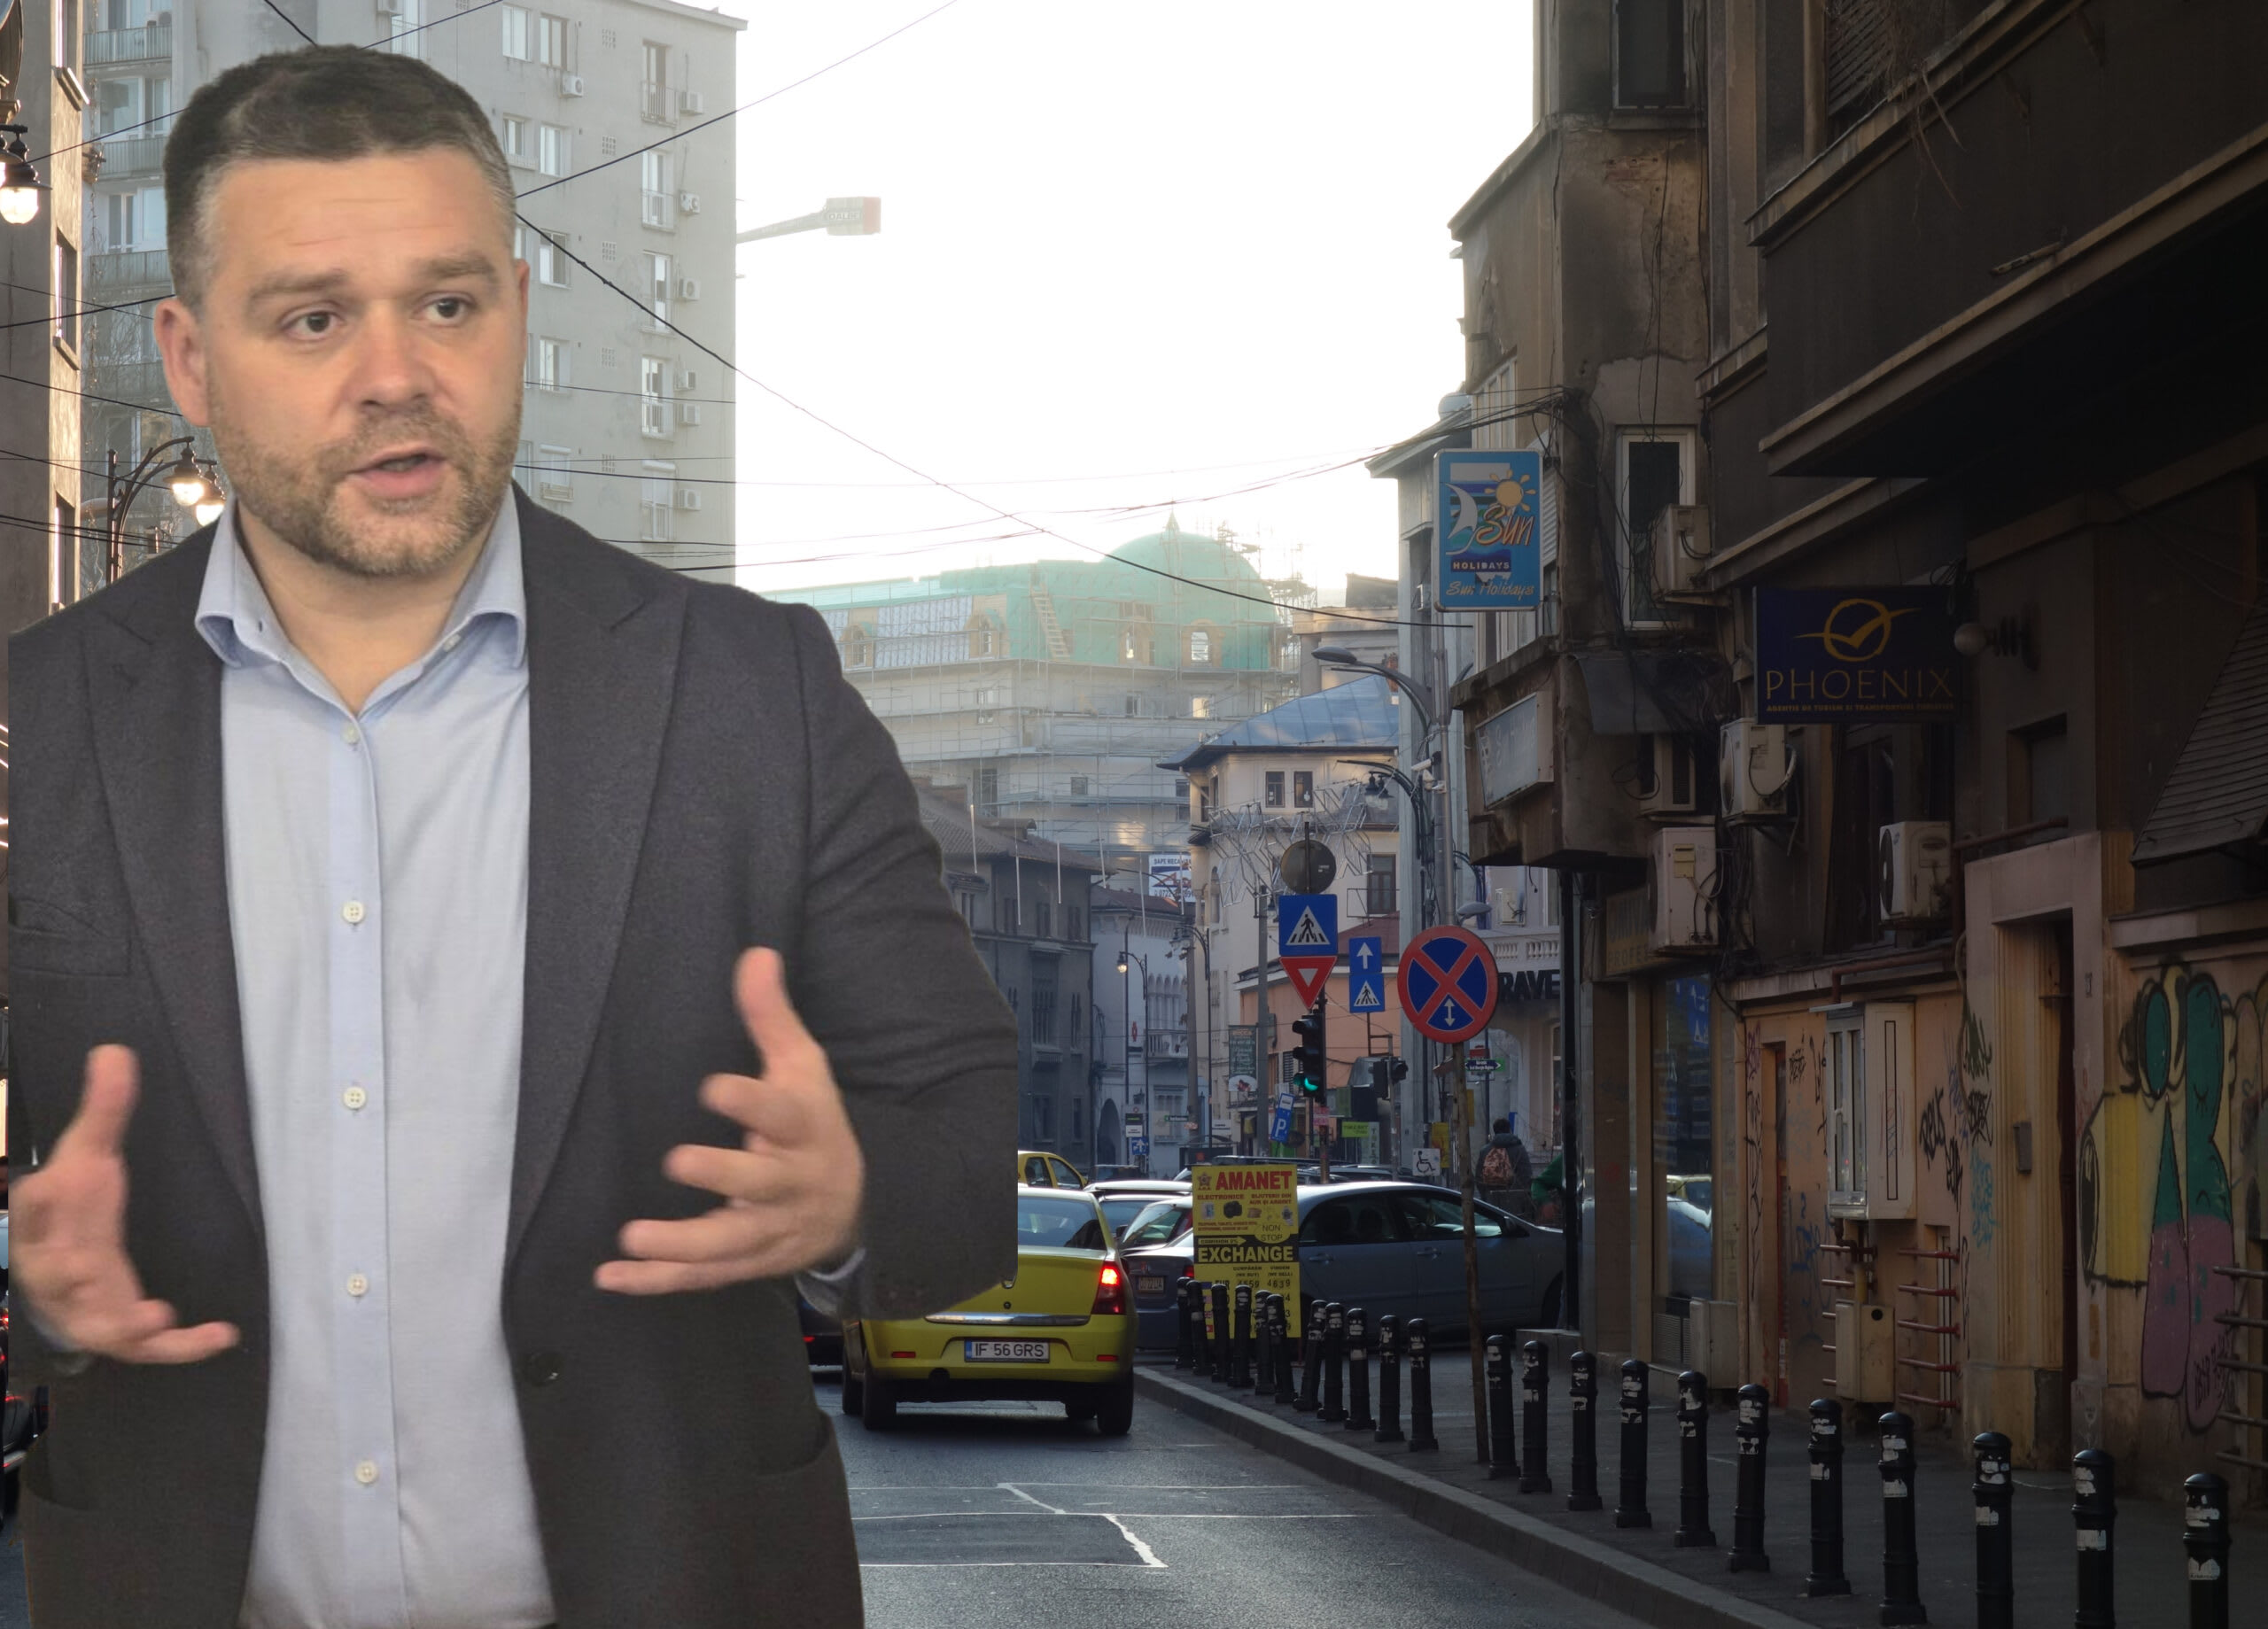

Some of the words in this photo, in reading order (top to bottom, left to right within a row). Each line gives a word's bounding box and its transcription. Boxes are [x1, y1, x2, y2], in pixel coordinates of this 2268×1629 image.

[1475, 502, 1535, 547] Sun
[1453, 562, 1511, 570] HOLIDAYS
[1446, 581, 1475, 596] Sun
[1479, 581, 1535, 601] Holidays
[1766, 668, 1954, 701] PHOENIX
[1215, 1170, 1293, 1191] AMANET
[1198, 1245, 1293, 1263] EXCHANGE
[975, 1343, 989, 1356] IF
[993, 1343, 1011, 1356] 56
[1014, 1344, 1045, 1357] GRS
